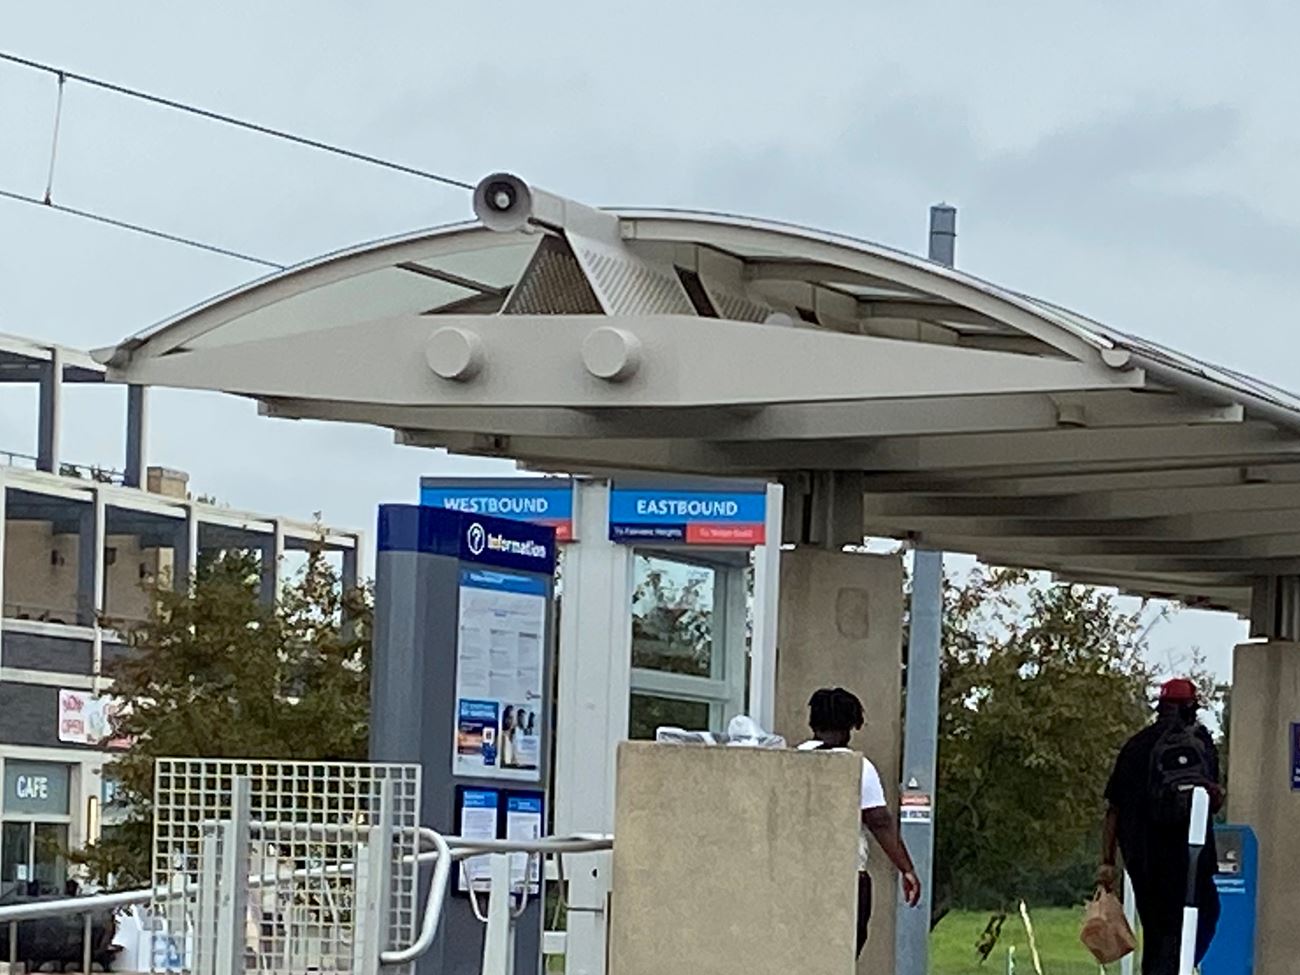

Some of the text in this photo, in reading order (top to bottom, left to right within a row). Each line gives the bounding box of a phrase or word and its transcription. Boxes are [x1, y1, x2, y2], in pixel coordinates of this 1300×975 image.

[443, 497, 549, 514] WESTBOUND
[636, 499, 738, 517] EASTBOUND
[487, 532, 547, 559] Information
[16, 775, 48, 799] CAFE
